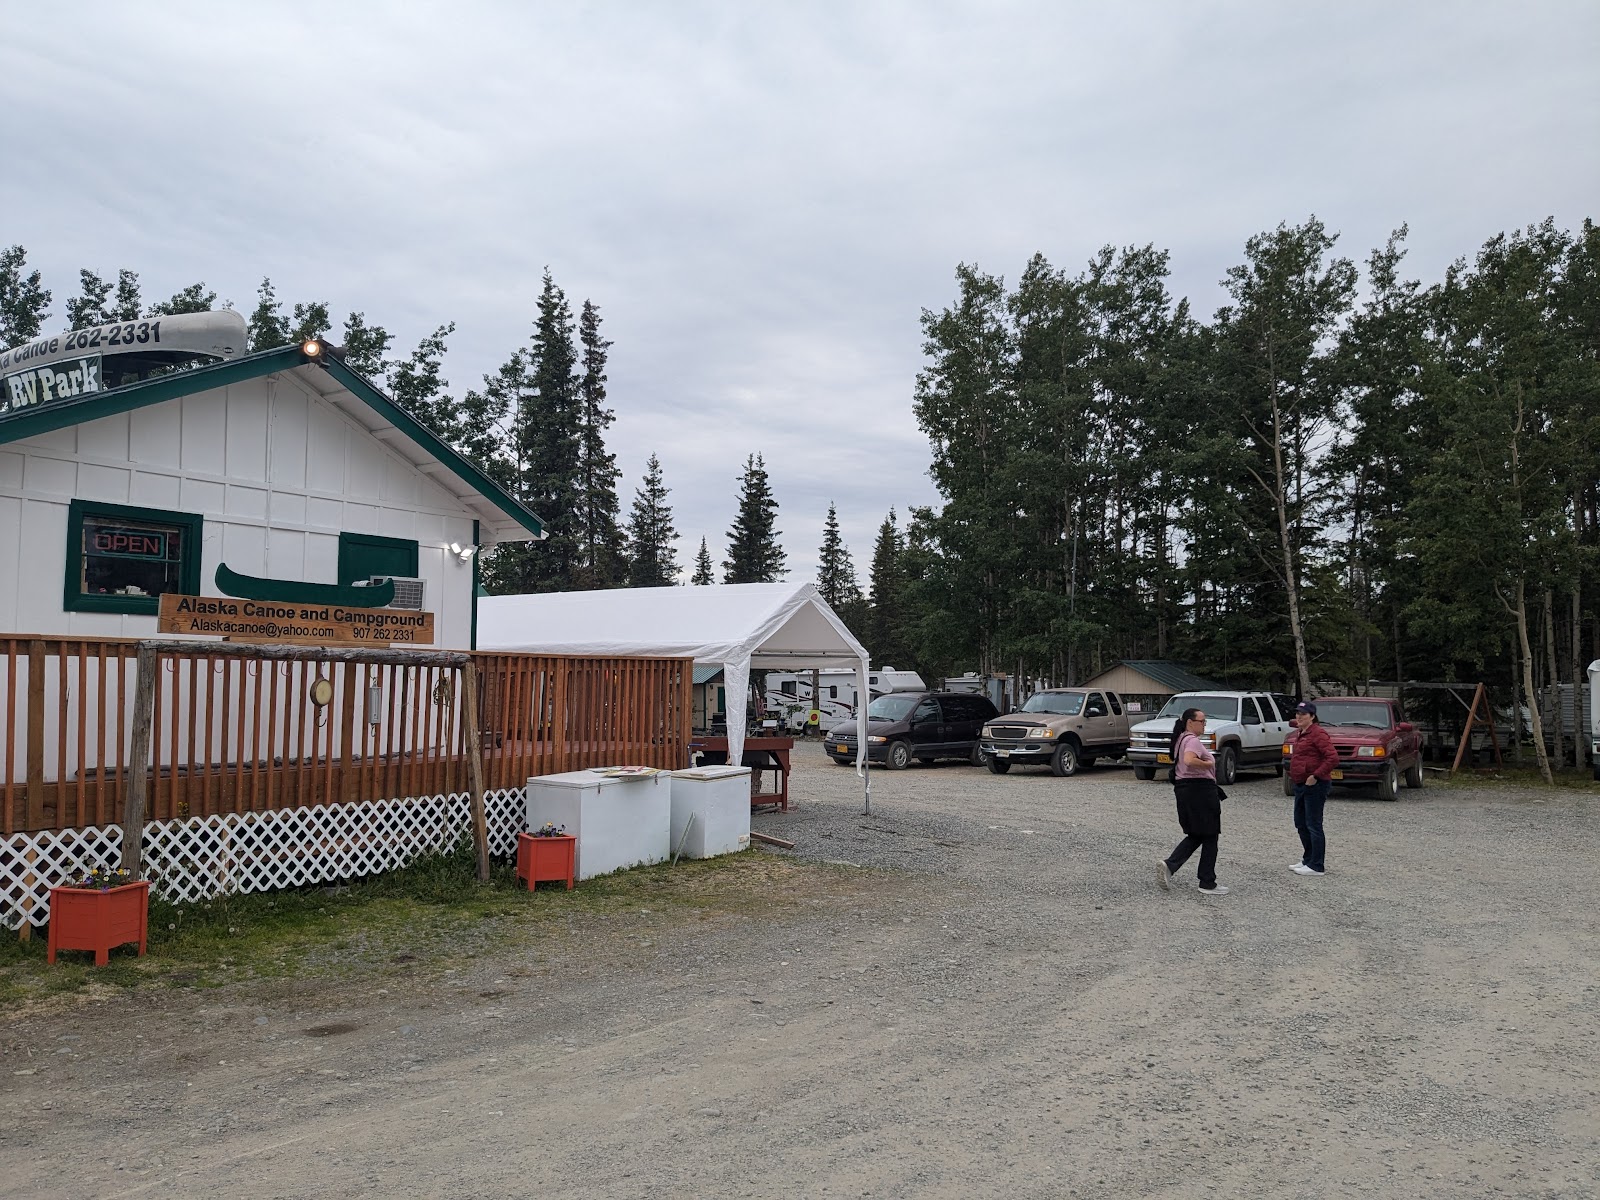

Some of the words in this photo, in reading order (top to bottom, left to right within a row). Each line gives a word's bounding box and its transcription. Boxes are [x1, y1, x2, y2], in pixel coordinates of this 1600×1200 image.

[14, 338, 58, 363] Canoe
[65, 322, 160, 351] 262-2331
[8, 371, 37, 408] RV
[38, 360, 98, 401] Park
[94, 533, 159, 554] OPEN
[177, 598, 238, 615] Alaska
[243, 602, 295, 619] Canoe
[300, 608, 329, 620] and
[334, 609, 425, 627] Campground
[190, 618, 334, 638] Alaskacanoe@yahoo.com
[353, 628, 370, 639] 907
[373, 628, 390, 640] 262
[392, 629, 414, 640] 2331
